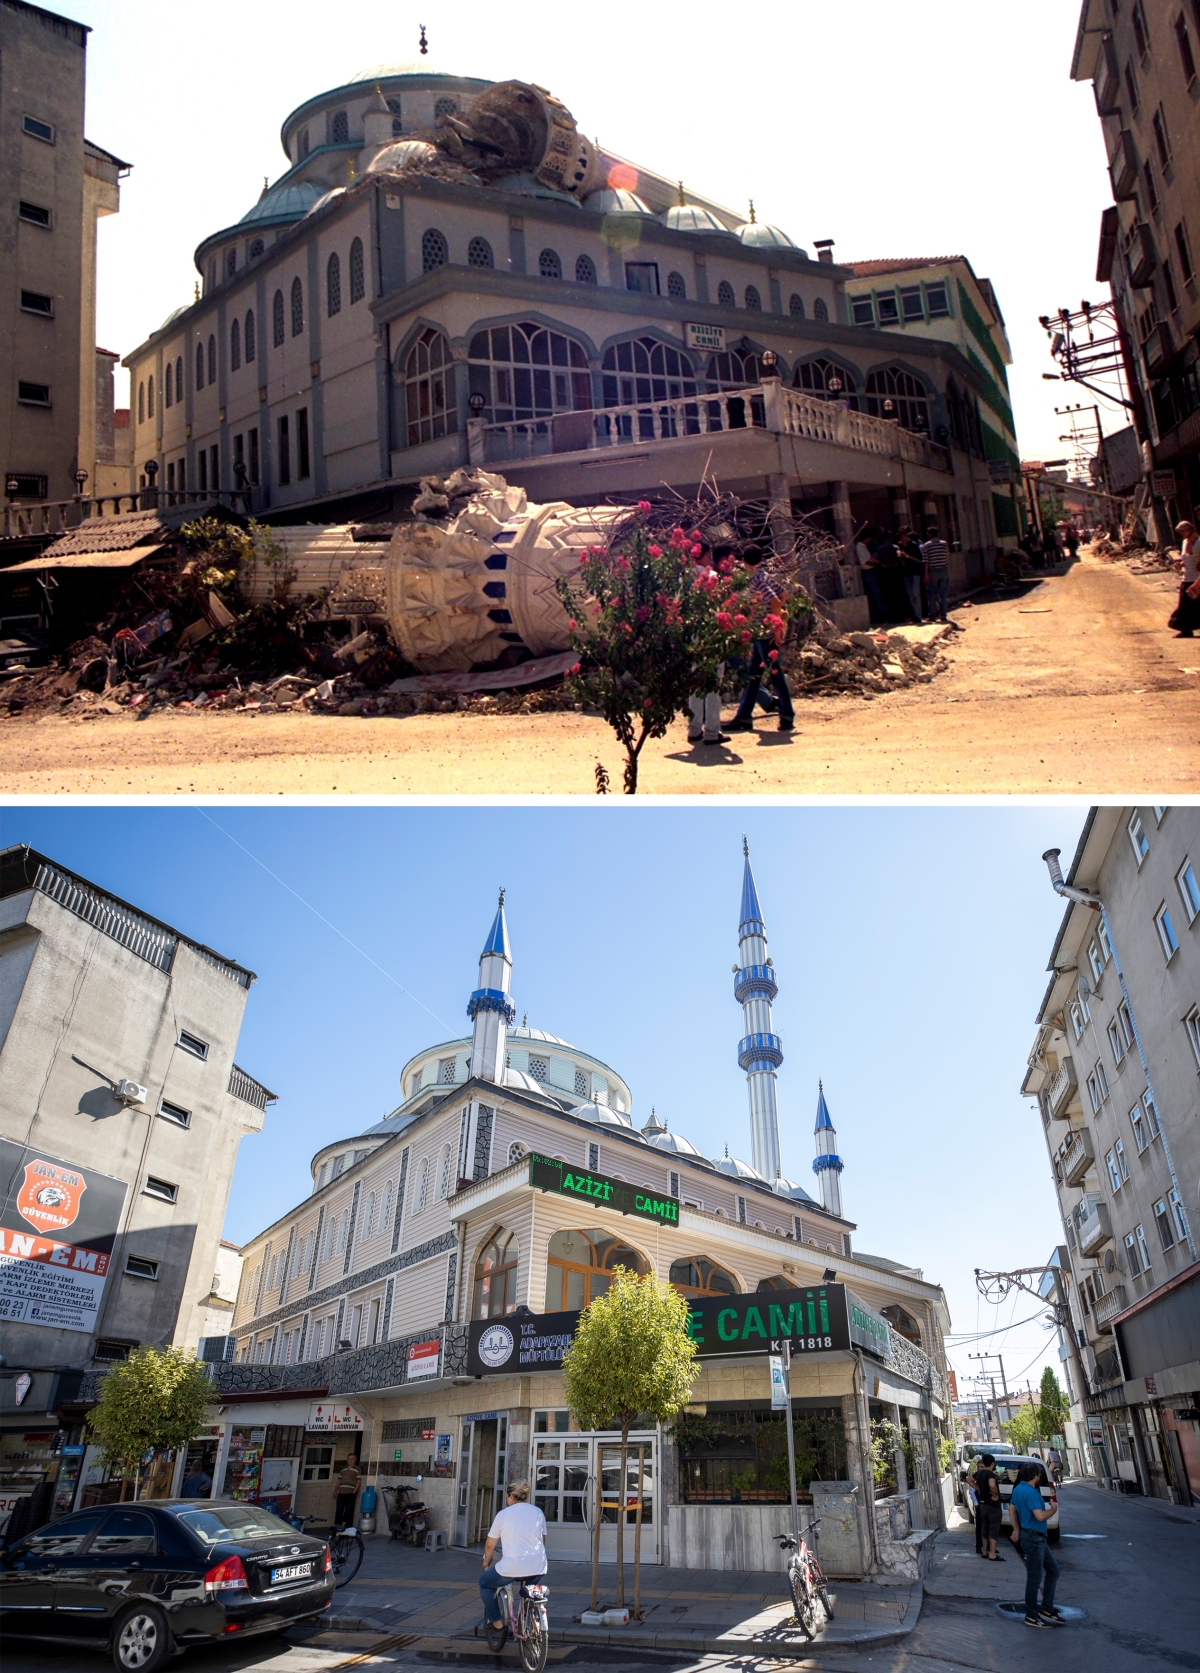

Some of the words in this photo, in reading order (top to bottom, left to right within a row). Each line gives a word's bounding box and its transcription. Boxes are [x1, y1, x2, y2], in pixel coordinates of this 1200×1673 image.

[33, 1163, 79, 1186] JAN-EM
[635, 1194, 678, 1221] CAMİİ
[22, 1206, 70, 1226] GÜVENLİK
[0, 1230, 98, 1272] N-EM
[0, 1256, 46, 1271] GÜVENLİK
[24, 1274, 56, 1287] İZLEME
[58, 1282, 94, 1295] MERKEZİ
[41, 1272, 74, 1284] EĞİTİMİ
[6, 1280, 28, 1289] KAPI
[30, 1284, 94, 1302] DEDEKTÖRLERİ
[12, 1300, 24, 1310] 23
[15, 1290, 46, 1300] ALARM
[48, 1294, 97, 1309] SİSTEMLERİ
[10, 1309, 21, 1317] 51
[40, 1310, 82, 1321] janemguvenlik
[42, 1303, 84, 1314] janemguvenlik
[717, 1290, 830, 1342] CAMİİ
[30, 1314, 85, 1327] www.jan-em.com
[520, 1324, 536, 1335] T.C.
[520, 1334, 572, 1349] ADAPAZARI
[799, 1336, 832, 1349] 1818
[275, 1569, 284, 1579] 54
[286, 1566, 298, 1578] AFT
[299, 1564, 310, 1574] 860
